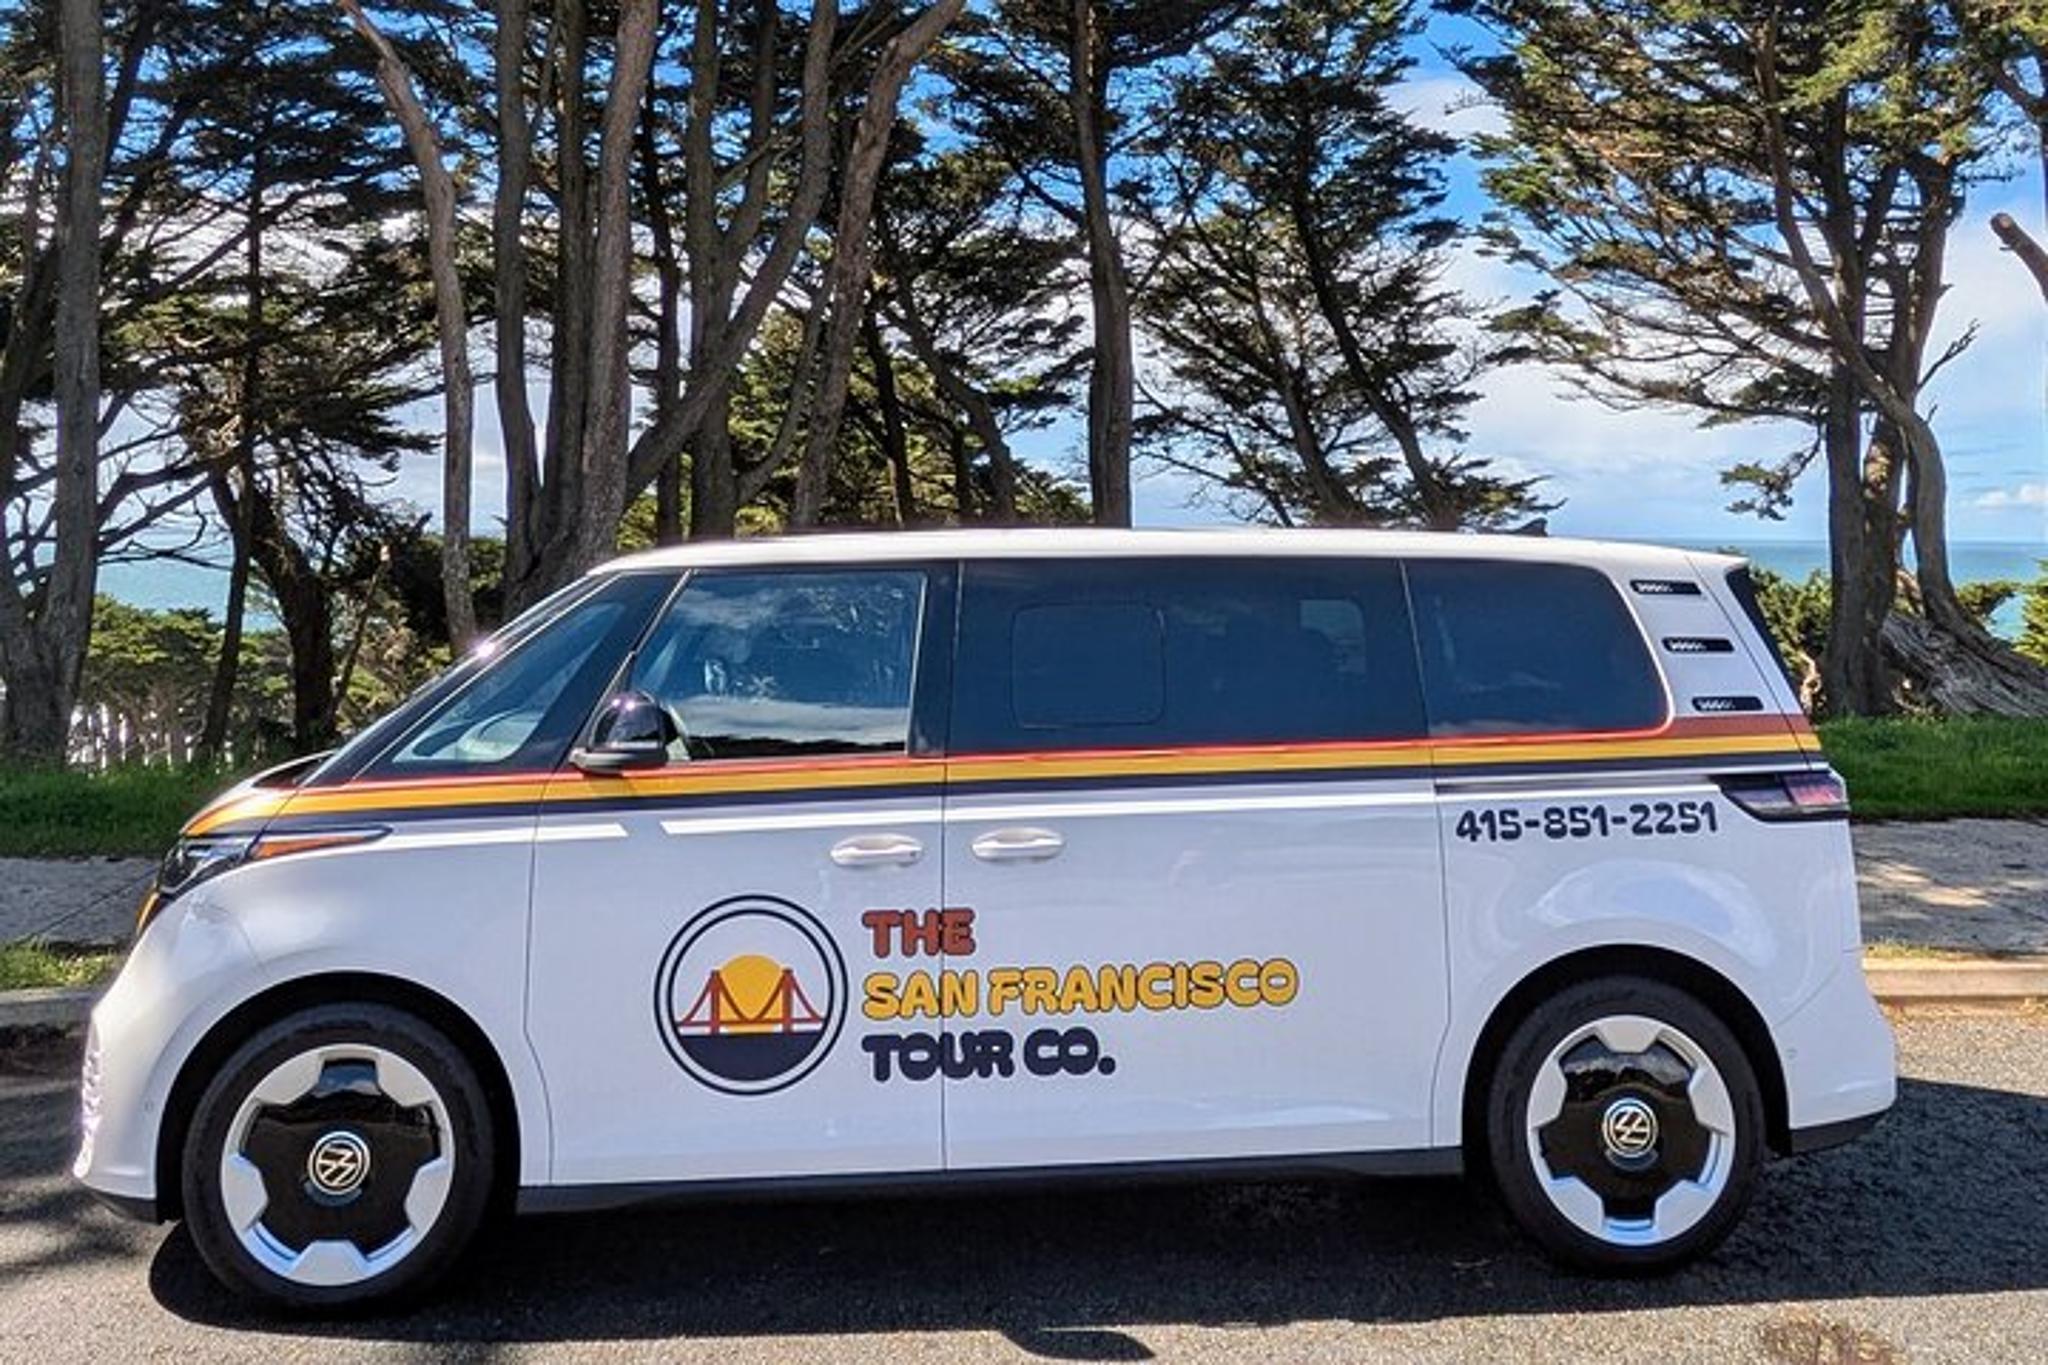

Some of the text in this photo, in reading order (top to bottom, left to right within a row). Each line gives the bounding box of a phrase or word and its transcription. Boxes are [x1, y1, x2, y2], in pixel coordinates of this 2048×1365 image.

[1455, 801, 1717, 843] 415-851-2251
[861, 907, 977, 959] THE
[861, 957, 1301, 1021] SAN FRANCISCO
[861, 1026, 1117, 1083] TOUR CO.
